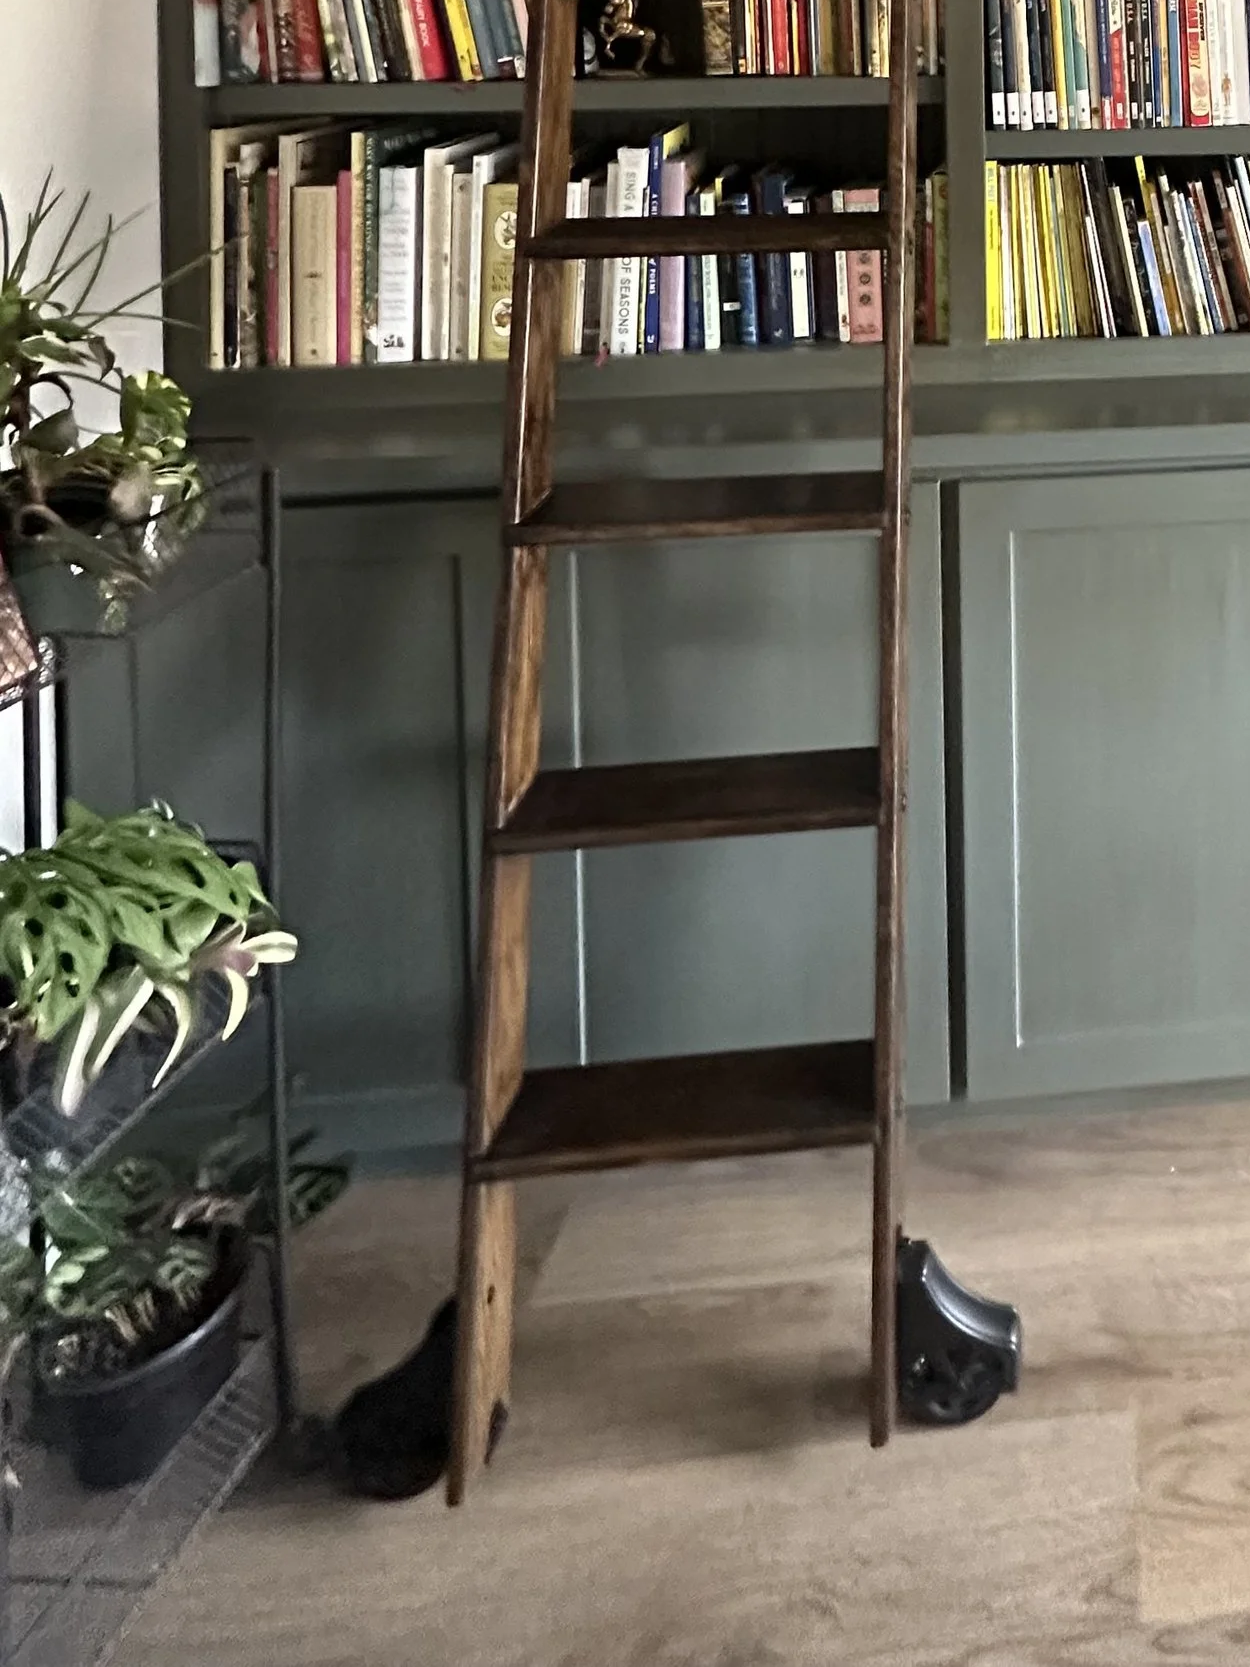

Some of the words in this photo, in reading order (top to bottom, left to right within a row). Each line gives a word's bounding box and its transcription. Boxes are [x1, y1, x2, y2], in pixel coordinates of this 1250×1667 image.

[418, 22, 429, 46] BOOK
[624, 171, 637, 191] SING
[620, 257, 632, 272] OF
[618, 277, 632, 335] SEASONS
